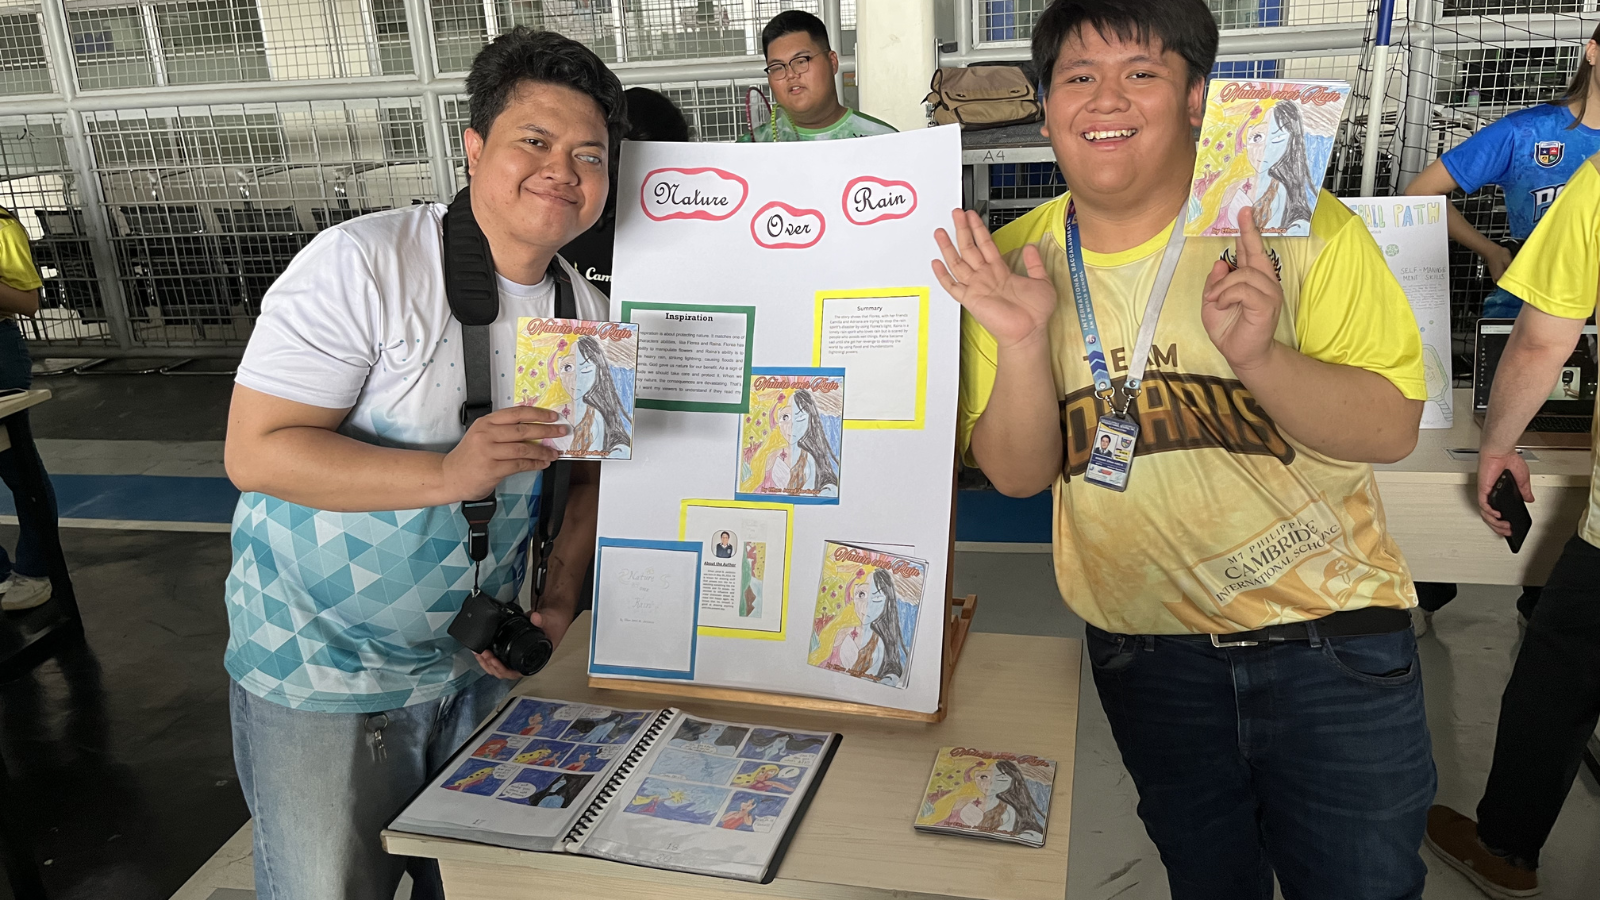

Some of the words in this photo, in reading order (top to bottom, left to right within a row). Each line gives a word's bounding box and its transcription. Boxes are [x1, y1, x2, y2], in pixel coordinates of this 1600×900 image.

[1220, 82, 1271, 103] Nature
[1271, 90, 1300, 100] over
[1300, 85, 1340, 106] Rain
[982, 150, 1005, 162] A4
[654, 181, 729, 207] Nature
[854, 187, 906, 212] Rain
[766, 214, 812, 238] Over
[1392, 202, 1440, 228] PATH
[1074, 272, 1088, 331] INTERNATIONAL
[666, 312, 714, 322] Inspiration
[527, 318, 572, 336] Nature
[573, 326, 598, 336] over
[598, 322, 632, 342] Rain
[754, 376, 790, 392] Nature
[790, 380, 810, 390] over
[810, 377, 840, 394] Rain
[1248, 519, 1302, 552] PHILIPPI
[834, 546, 872, 565] Nature
[871, 558, 892, 570] over
[892, 560, 920, 578] Rain
[1224, 519, 1320, 580] CAMBRIDE
[1216, 555, 1294, 602] INTERNATIONAL
[1294, 539, 1326, 559] SCHO
